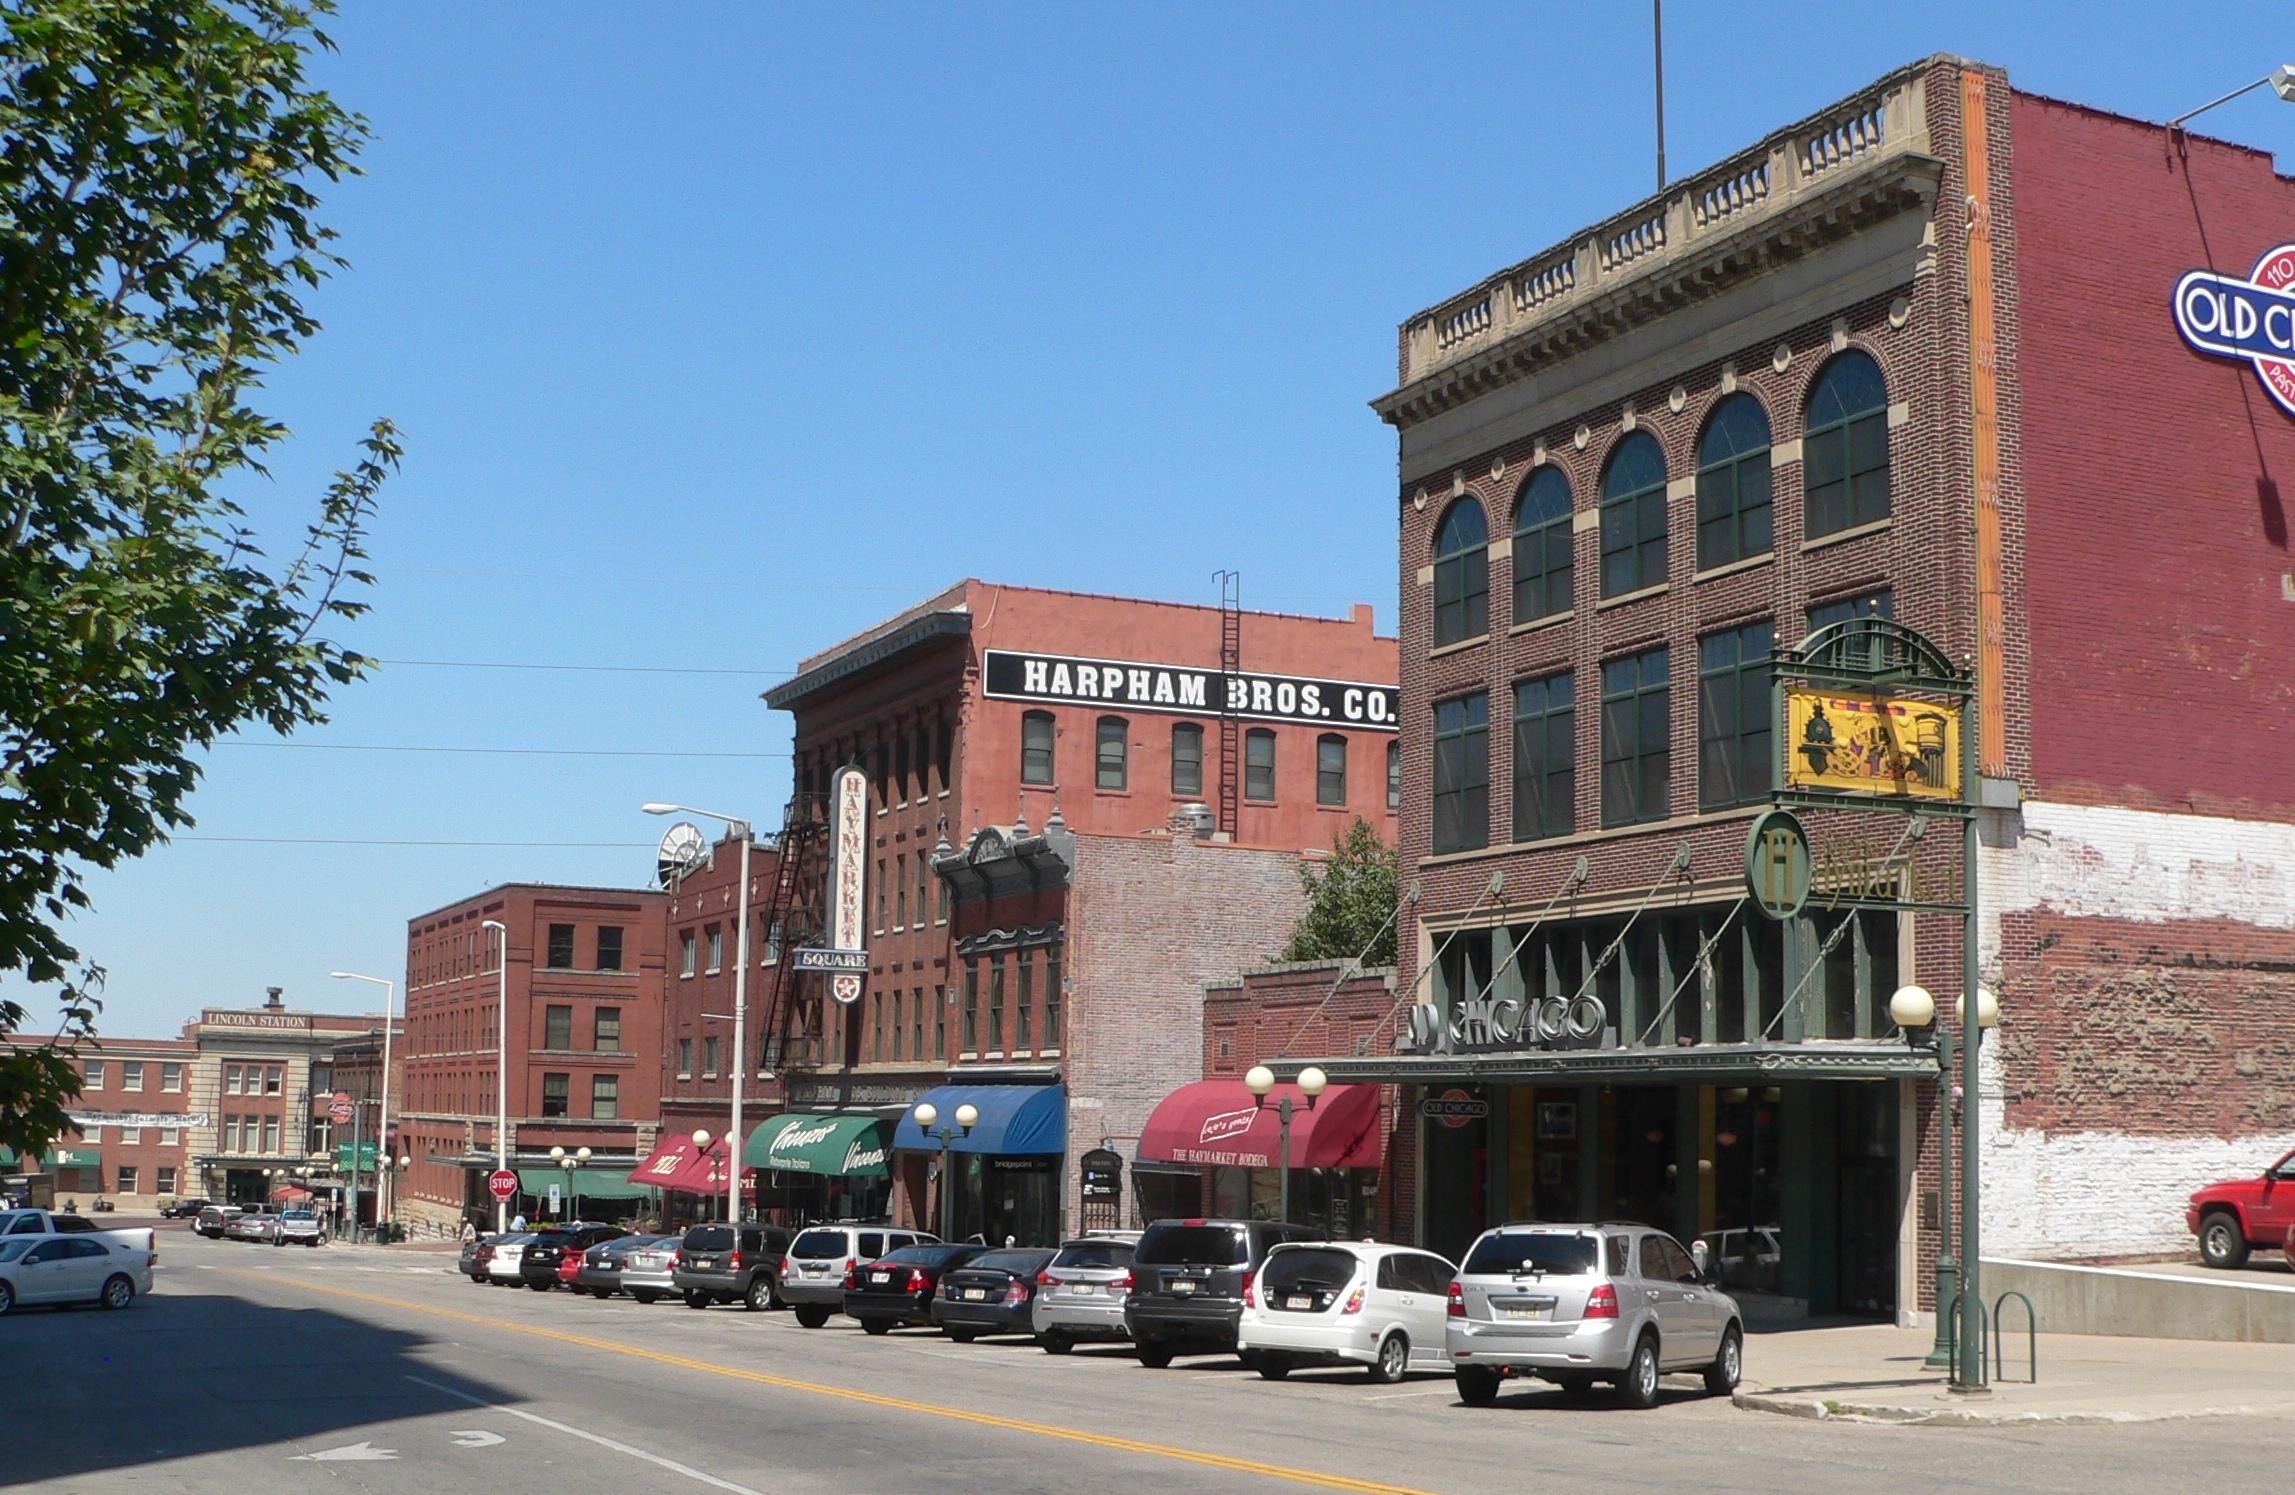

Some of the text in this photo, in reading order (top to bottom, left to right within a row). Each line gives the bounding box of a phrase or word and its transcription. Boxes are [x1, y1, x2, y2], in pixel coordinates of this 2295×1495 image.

[2267, 258, 2294, 287] 110
[2186, 287, 2257, 340] OLD
[1024, 660, 1396, 722] HARPHAM BROS. CO.
[841, 777, 862, 948] HAYMARKET
[802, 952, 866, 967] SQUARE
[208, 1013, 306, 1027] LINCOLN STATION
[1450, 995, 1607, 1045] CHICAGO
[1425, 1103, 1485, 1114] OLD CHICAGO
[1173, 1148, 1268, 1167] THE HAYMARKET BODEGA
[492, 1178, 515, 1189] STOP
